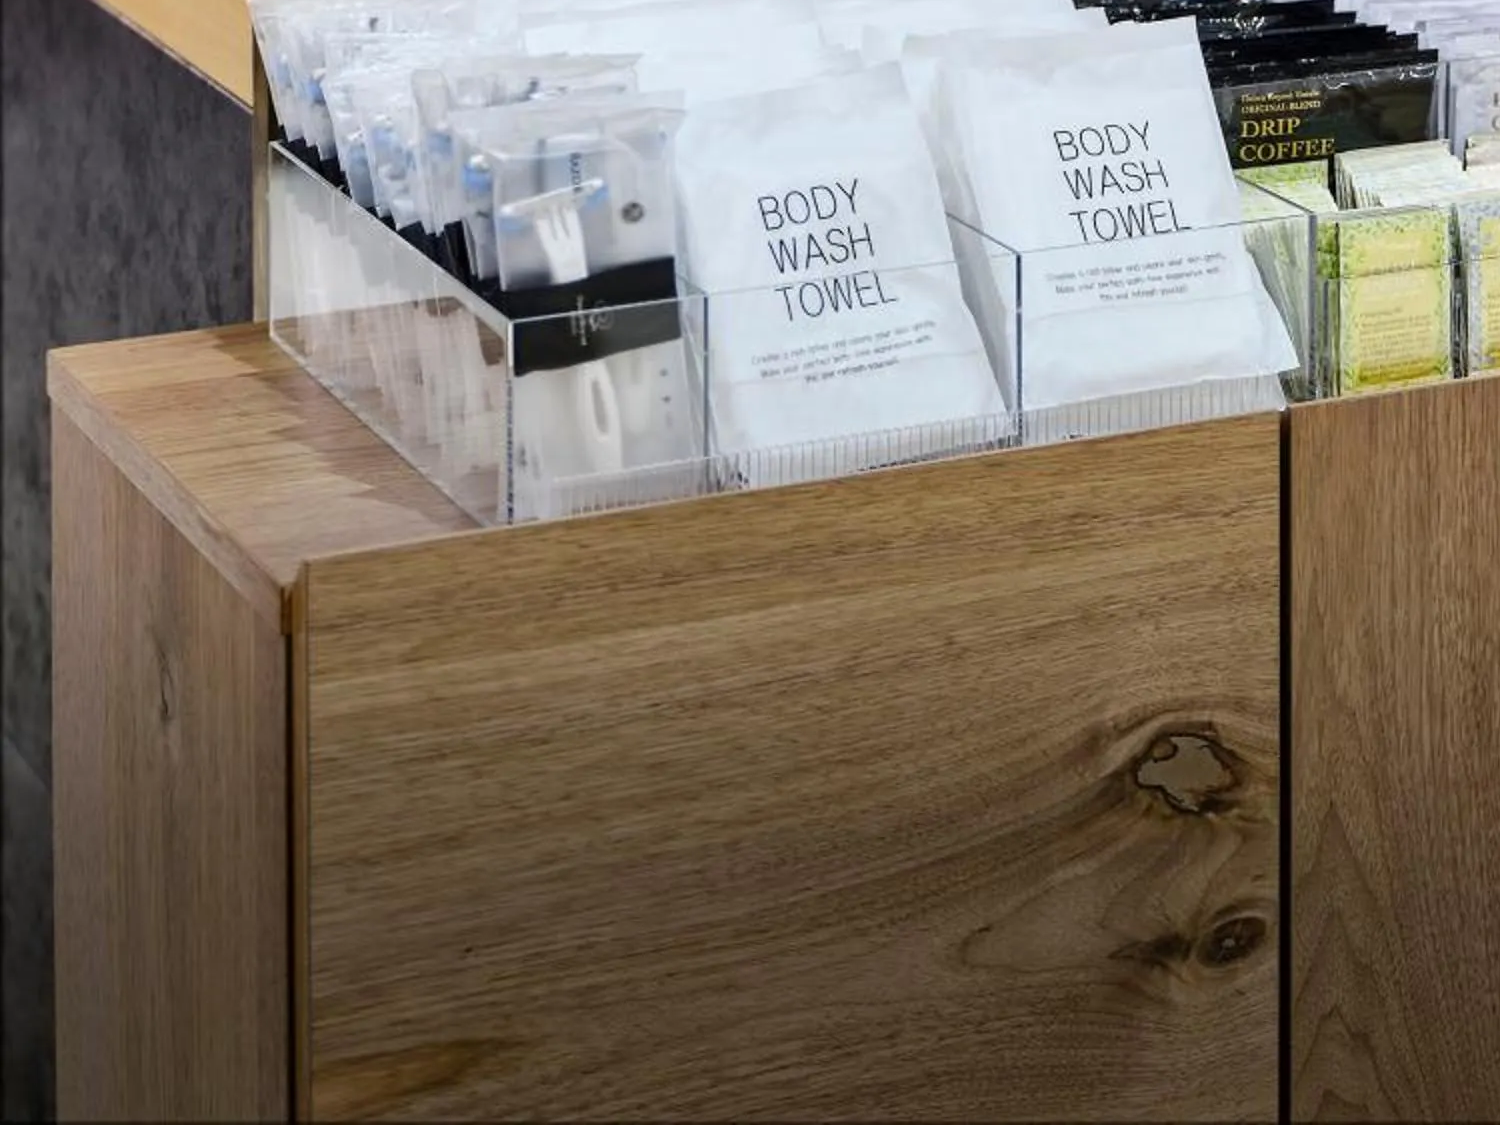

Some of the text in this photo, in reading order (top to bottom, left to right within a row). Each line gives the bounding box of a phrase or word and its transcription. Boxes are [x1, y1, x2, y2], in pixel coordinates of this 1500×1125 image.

[1053, 120, 1152, 162] BODY
[1240, 117, 1301, 138] DRIP
[1240, 138, 1335, 162] COFFEE
[1062, 159, 1170, 201] WASH
[757, 177, 860, 231] BODY
[1069, 198, 1193, 244] TOWEL
[767, 222, 875, 274] WASH
[775, 269, 898, 322] TOWEL
